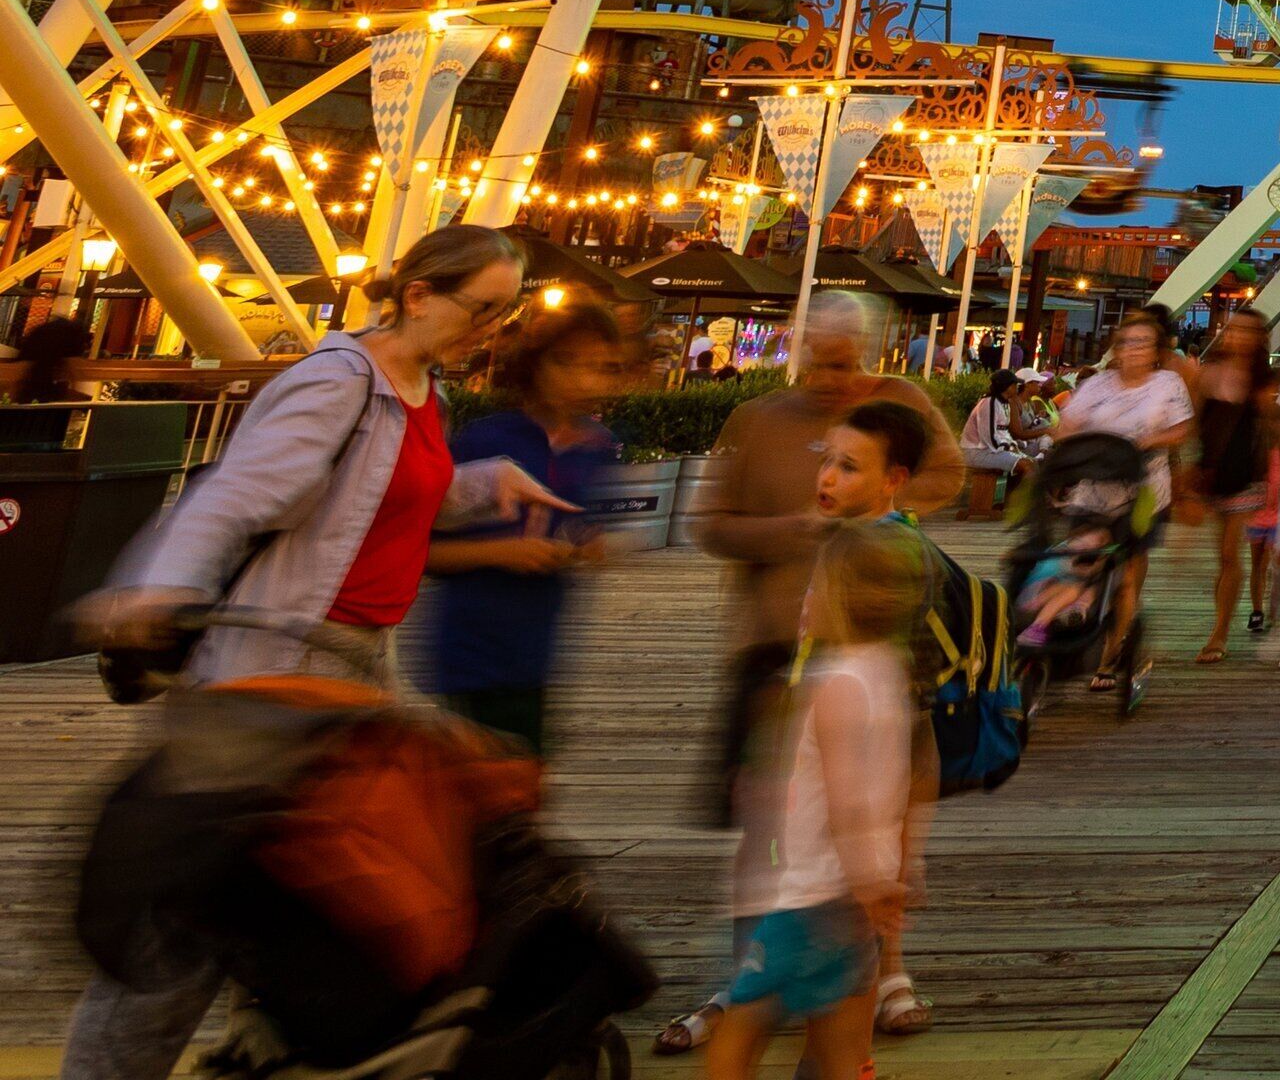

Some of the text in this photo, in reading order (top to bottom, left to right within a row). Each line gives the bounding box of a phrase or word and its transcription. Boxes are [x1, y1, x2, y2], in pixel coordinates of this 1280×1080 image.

[839, 121, 883, 138] MOREY'S
[1034, 192, 1068, 207] MOREY'S
[520, 277, 560, 288] steiner
[672, 277, 724, 287] Warsteiner
[820, 277, 867, 287] Warsteiner
